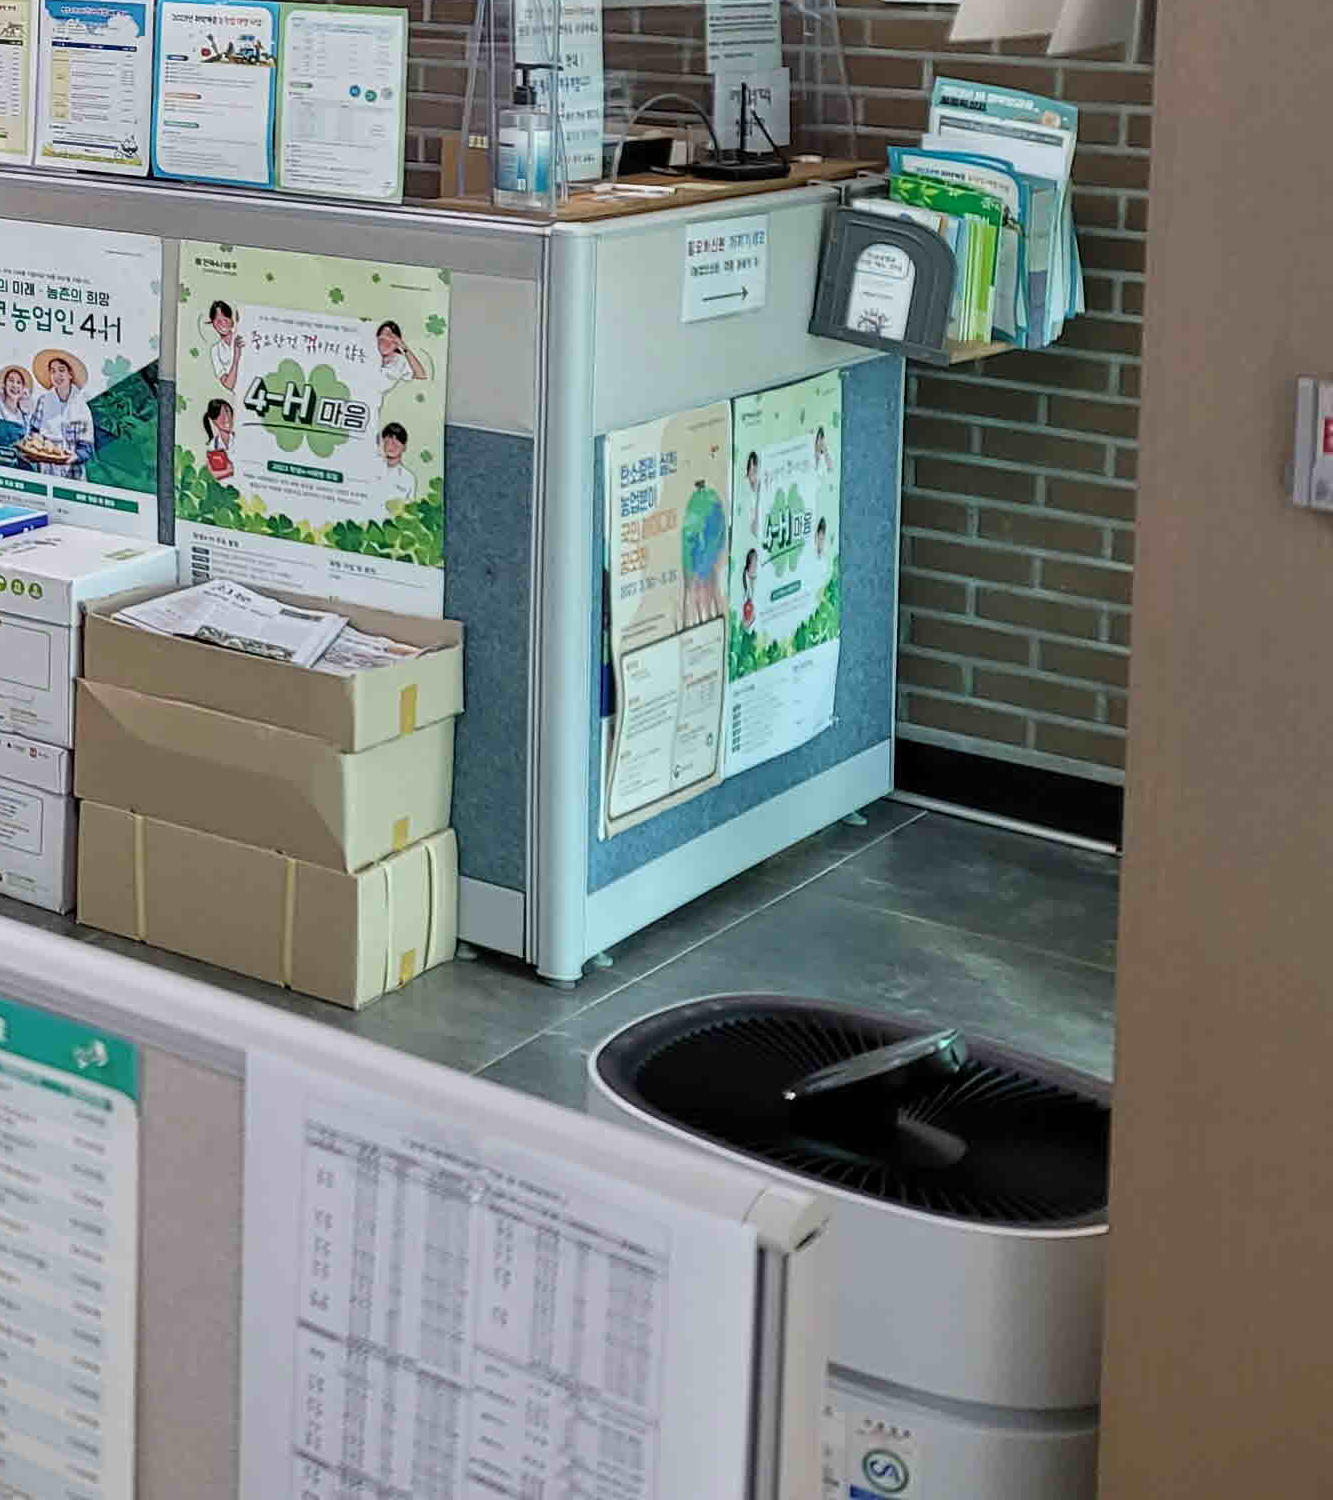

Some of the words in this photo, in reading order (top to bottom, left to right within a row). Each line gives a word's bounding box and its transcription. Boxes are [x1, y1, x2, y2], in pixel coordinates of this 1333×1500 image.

[12, 281, 35, 297] 미래
[46, 286, 83, 304] 농촌의
[86, 291, 110, 307] 희망
[244, 376, 317, 424] 4-H
[317, 397, 370, 432] 마음
